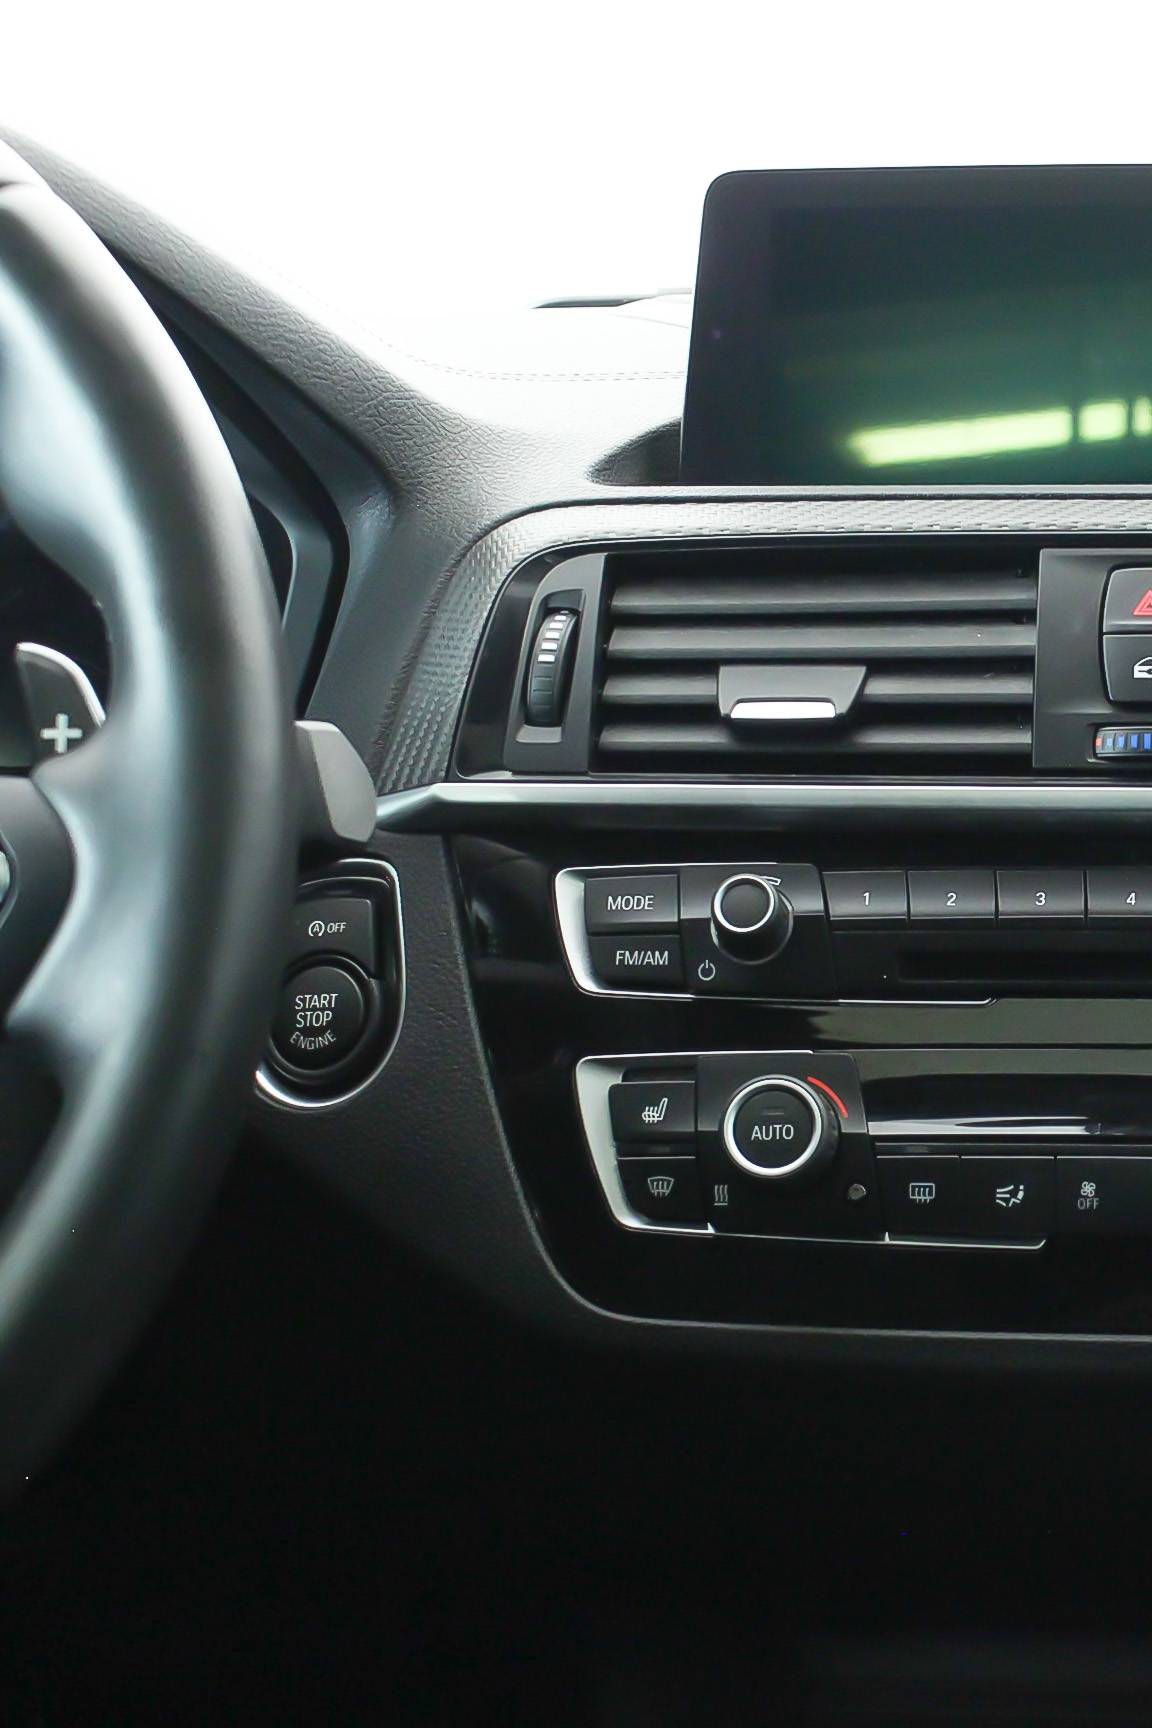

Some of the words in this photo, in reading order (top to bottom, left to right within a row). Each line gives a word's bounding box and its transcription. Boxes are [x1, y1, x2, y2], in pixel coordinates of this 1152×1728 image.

[607, 895, 654, 911] MODE
[862, 892, 870, 907] 1
[946, 893, 957, 907] 2
[1035, 892, 1046, 906] 3
[1126, 892, 1137, 906] 4
[326, 922, 347, 934] OFF
[615, 950, 669, 967] FM/AM
[294, 993, 339, 1010] START
[295, 1011, 333, 1028] STOP
[290, 1030, 337, 1050] ENGINE
[751, 1124, 795, 1142] AUTO
[1077, 1197, 1100, 1211] OFF
